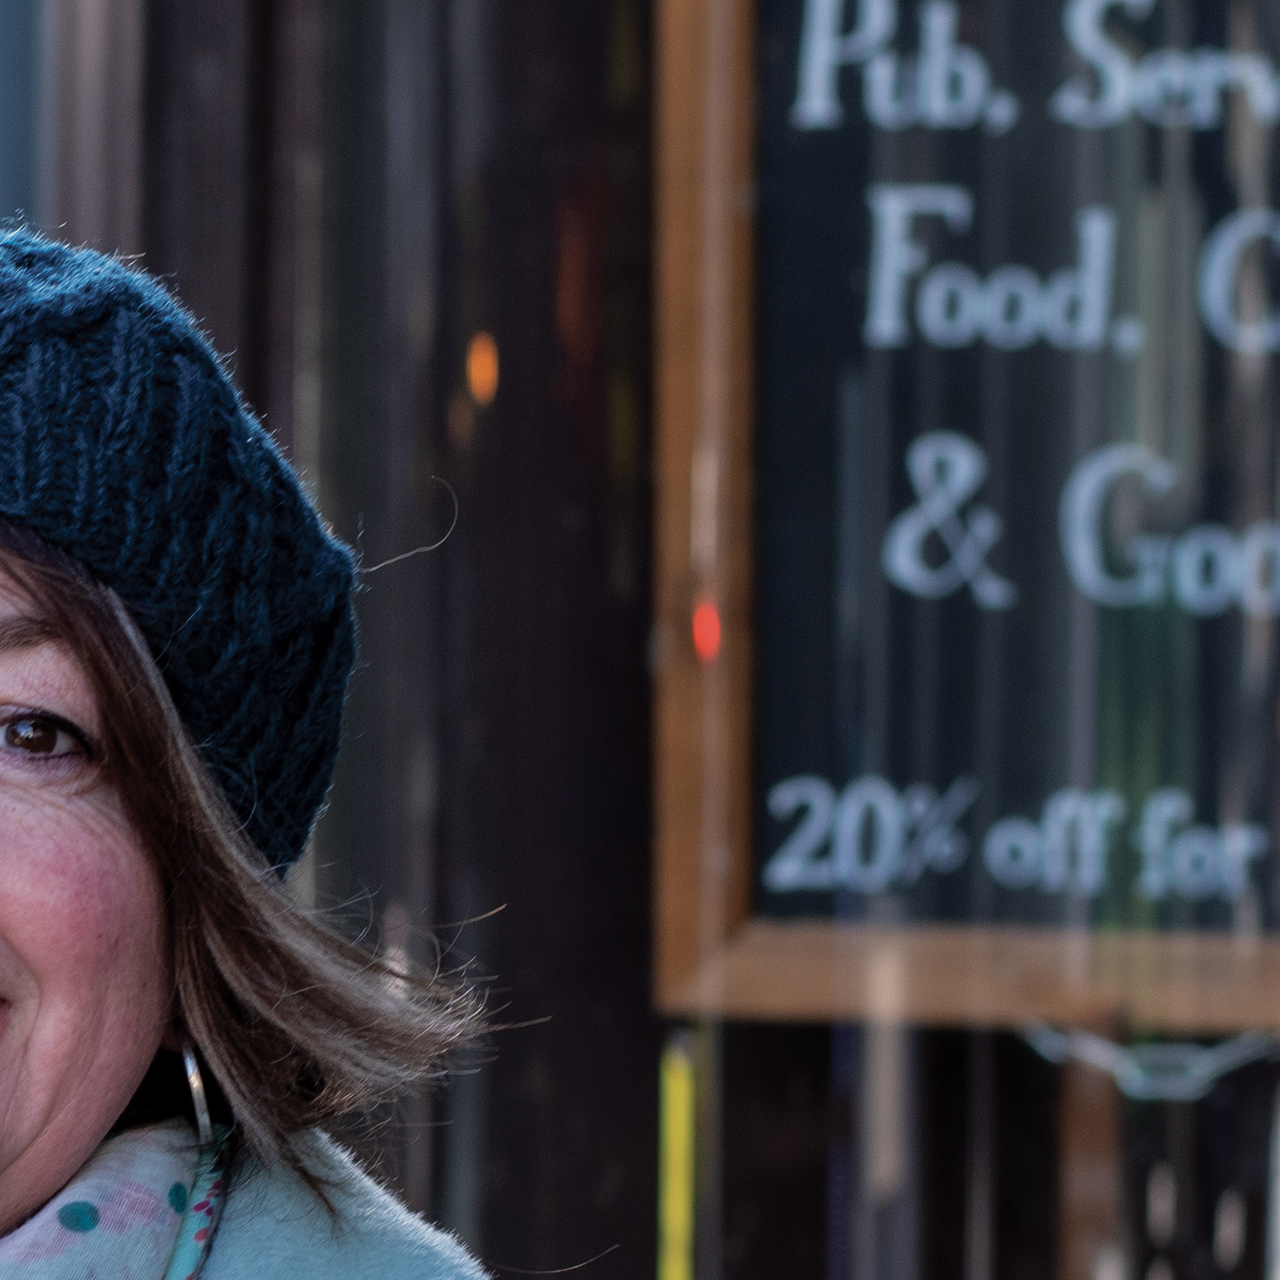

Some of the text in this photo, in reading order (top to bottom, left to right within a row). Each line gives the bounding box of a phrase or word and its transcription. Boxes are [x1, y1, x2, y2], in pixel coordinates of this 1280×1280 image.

[792, 0, 1018, 132] Pub.
[864, 183, 1143, 357] Food.
[882, 430, 1015, 607] &
[763, 775, 1267, 899] 20% off for
